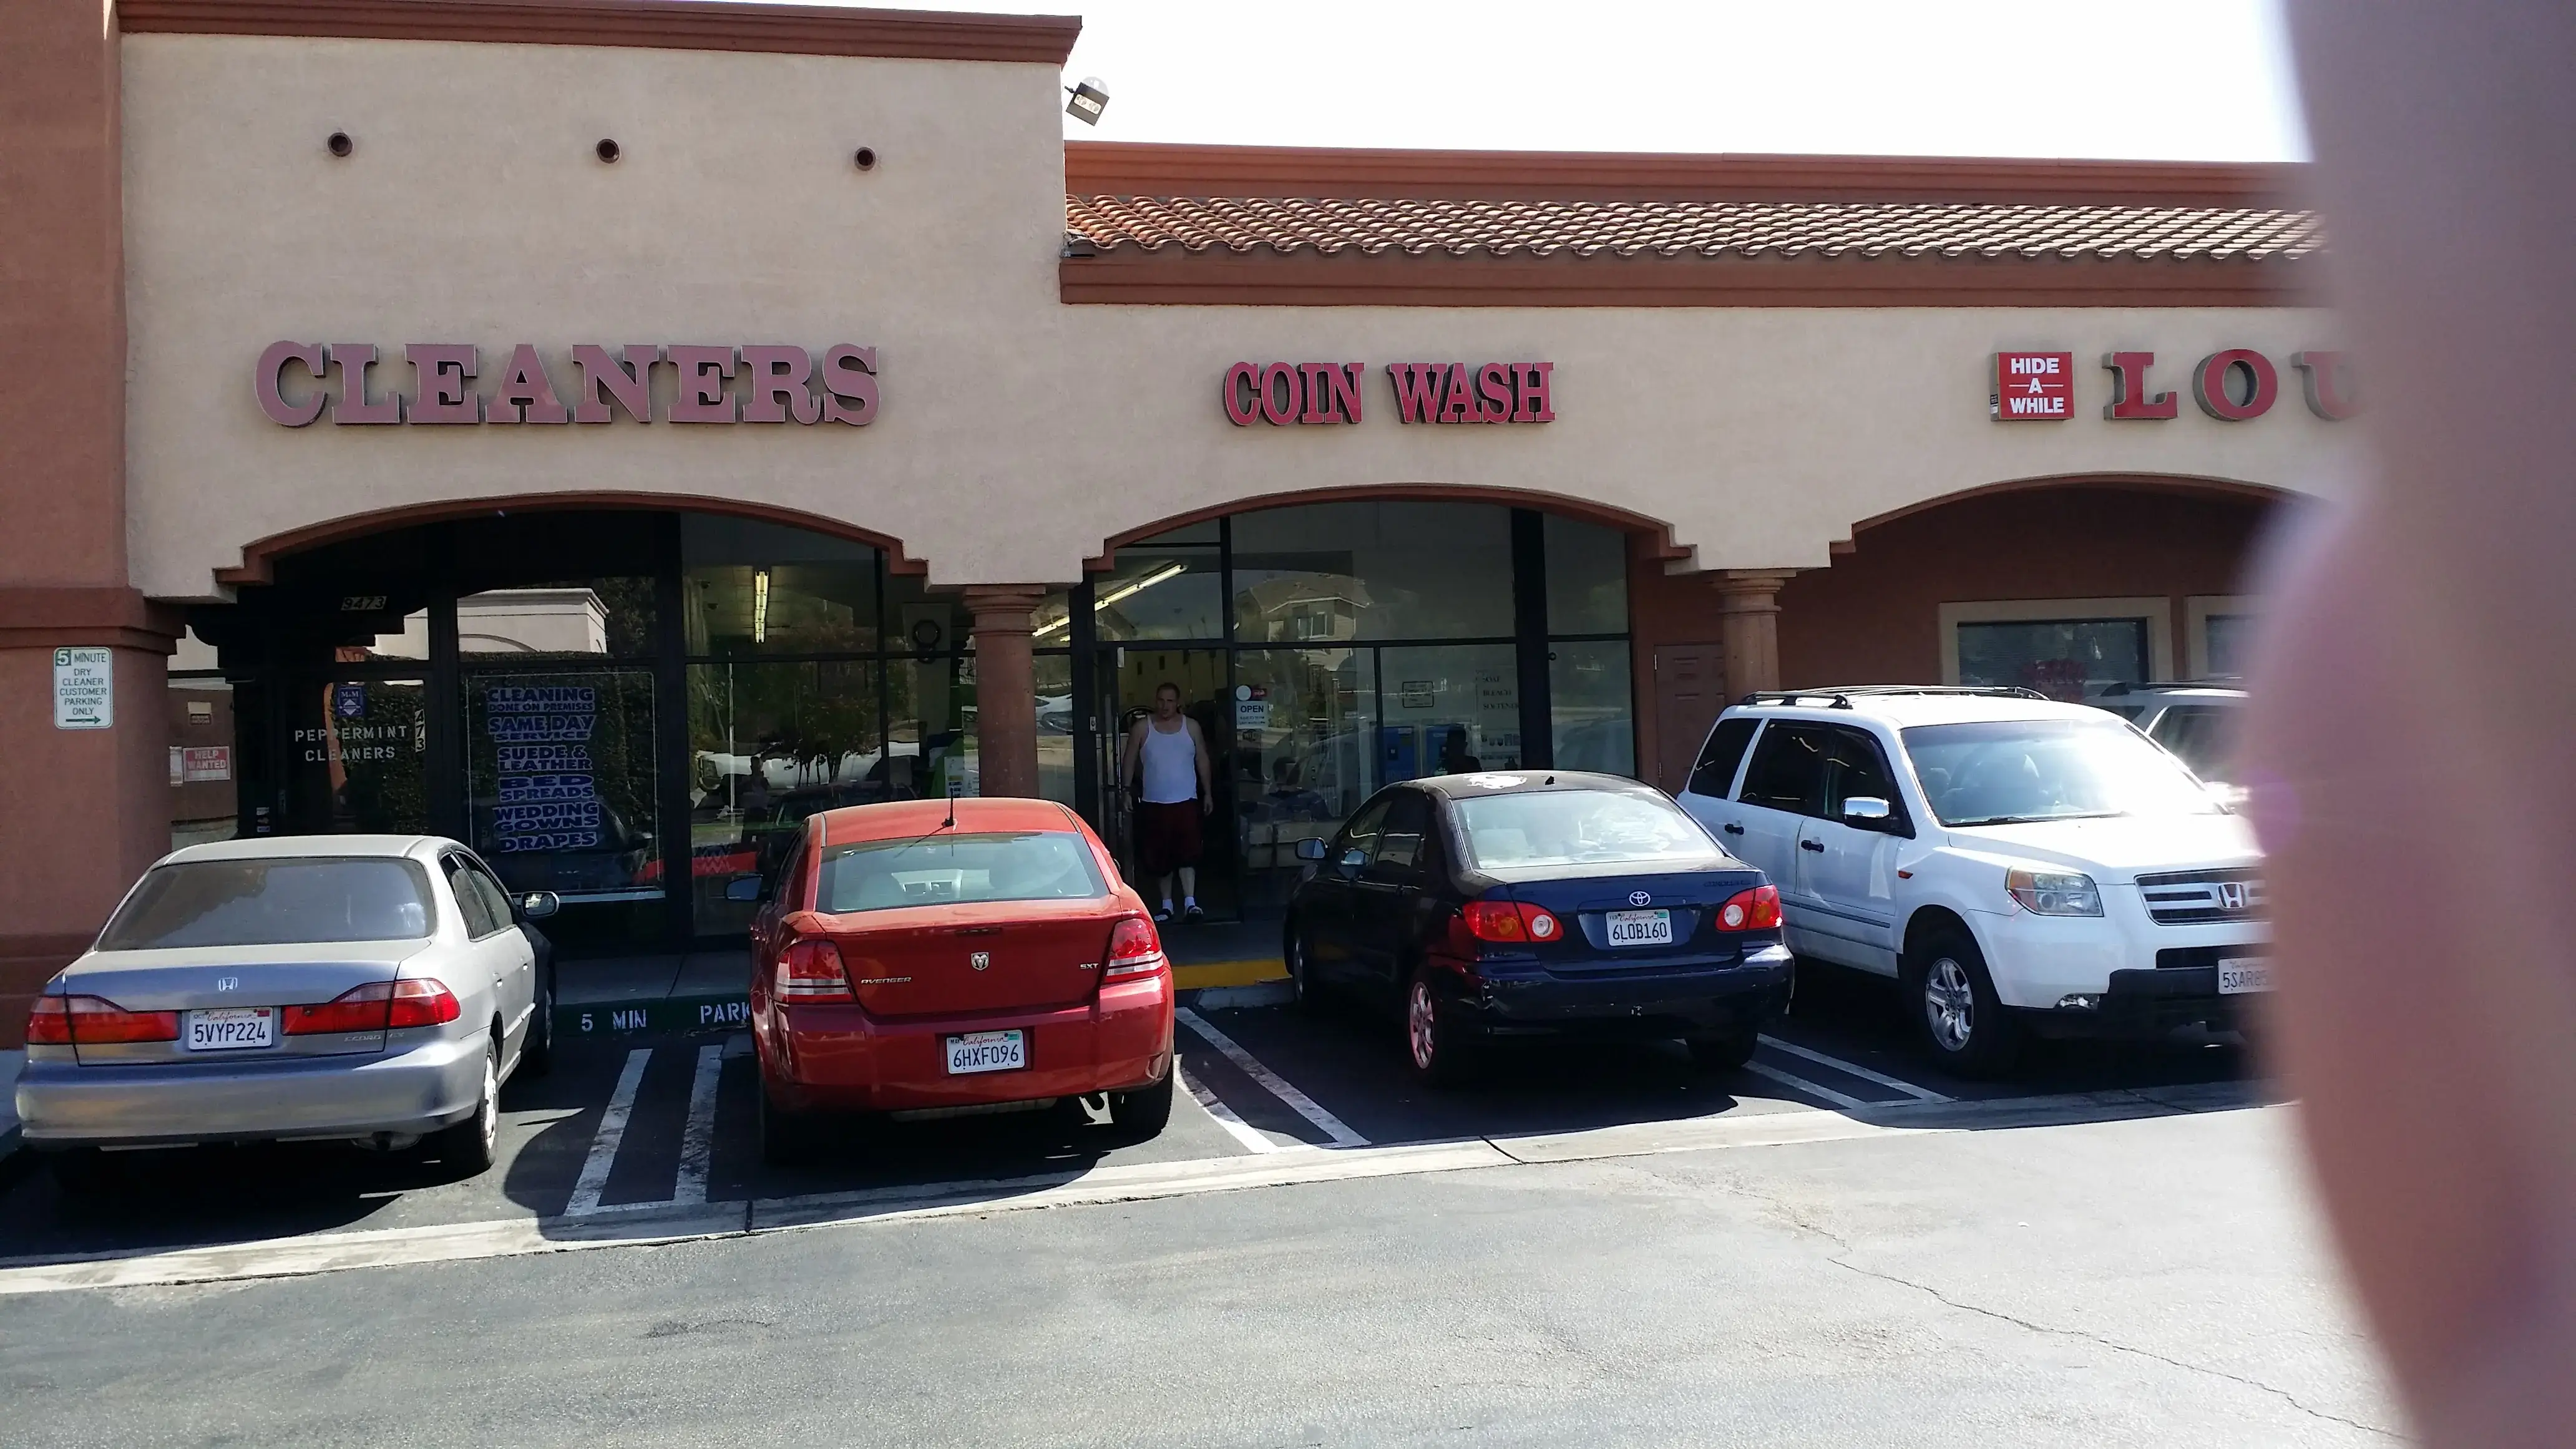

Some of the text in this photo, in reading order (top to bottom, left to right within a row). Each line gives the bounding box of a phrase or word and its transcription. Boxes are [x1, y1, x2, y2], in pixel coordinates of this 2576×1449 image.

[2011, 357, 2060, 374] HIDE
[255, 339, 881, 427] CLEANERS
[2028, 377, 2044, 394] A
[1224, 361, 1555, 426] COIN WASH
[2009, 397, 2065, 414] WHILE
[343, 597, 385, 610] 9473
[57, 650, 107, 666] 5 MINUTE
[62, 678, 104, 686] CLEANER
[59, 688, 107, 696] CUSTOMER
[487, 687, 595, 703] CLEANING
[64, 697, 103, 705] PARKING
[489, 701, 595, 712] DONE ON PREMISES
[72, 707, 94, 715] ONLY
[494, 731, 592, 743] SERVICE
[195, 749, 218, 759] HELP
[305, 746, 396, 761] CLEANERS
[498, 744, 588, 761] SUEDE &
[187, 759, 227, 770] WANTED
[498, 759, 593, 773] LEATHER
[499, 774, 594, 789] BED
[500, 786, 595, 803] SPREADS
[492, 801, 600, 821] WEDDING
[494, 816, 600, 832] GOWNS
[499, 832, 598, 852] DRAPES
[581, 1013, 593, 1032] 5
[612, 1008, 646, 1030] MIN
[195, 1022, 266, 1043] 5VYP224
[963, 1035, 1005, 1047] California
[953, 1044, 1019, 1068] 6HXF096
